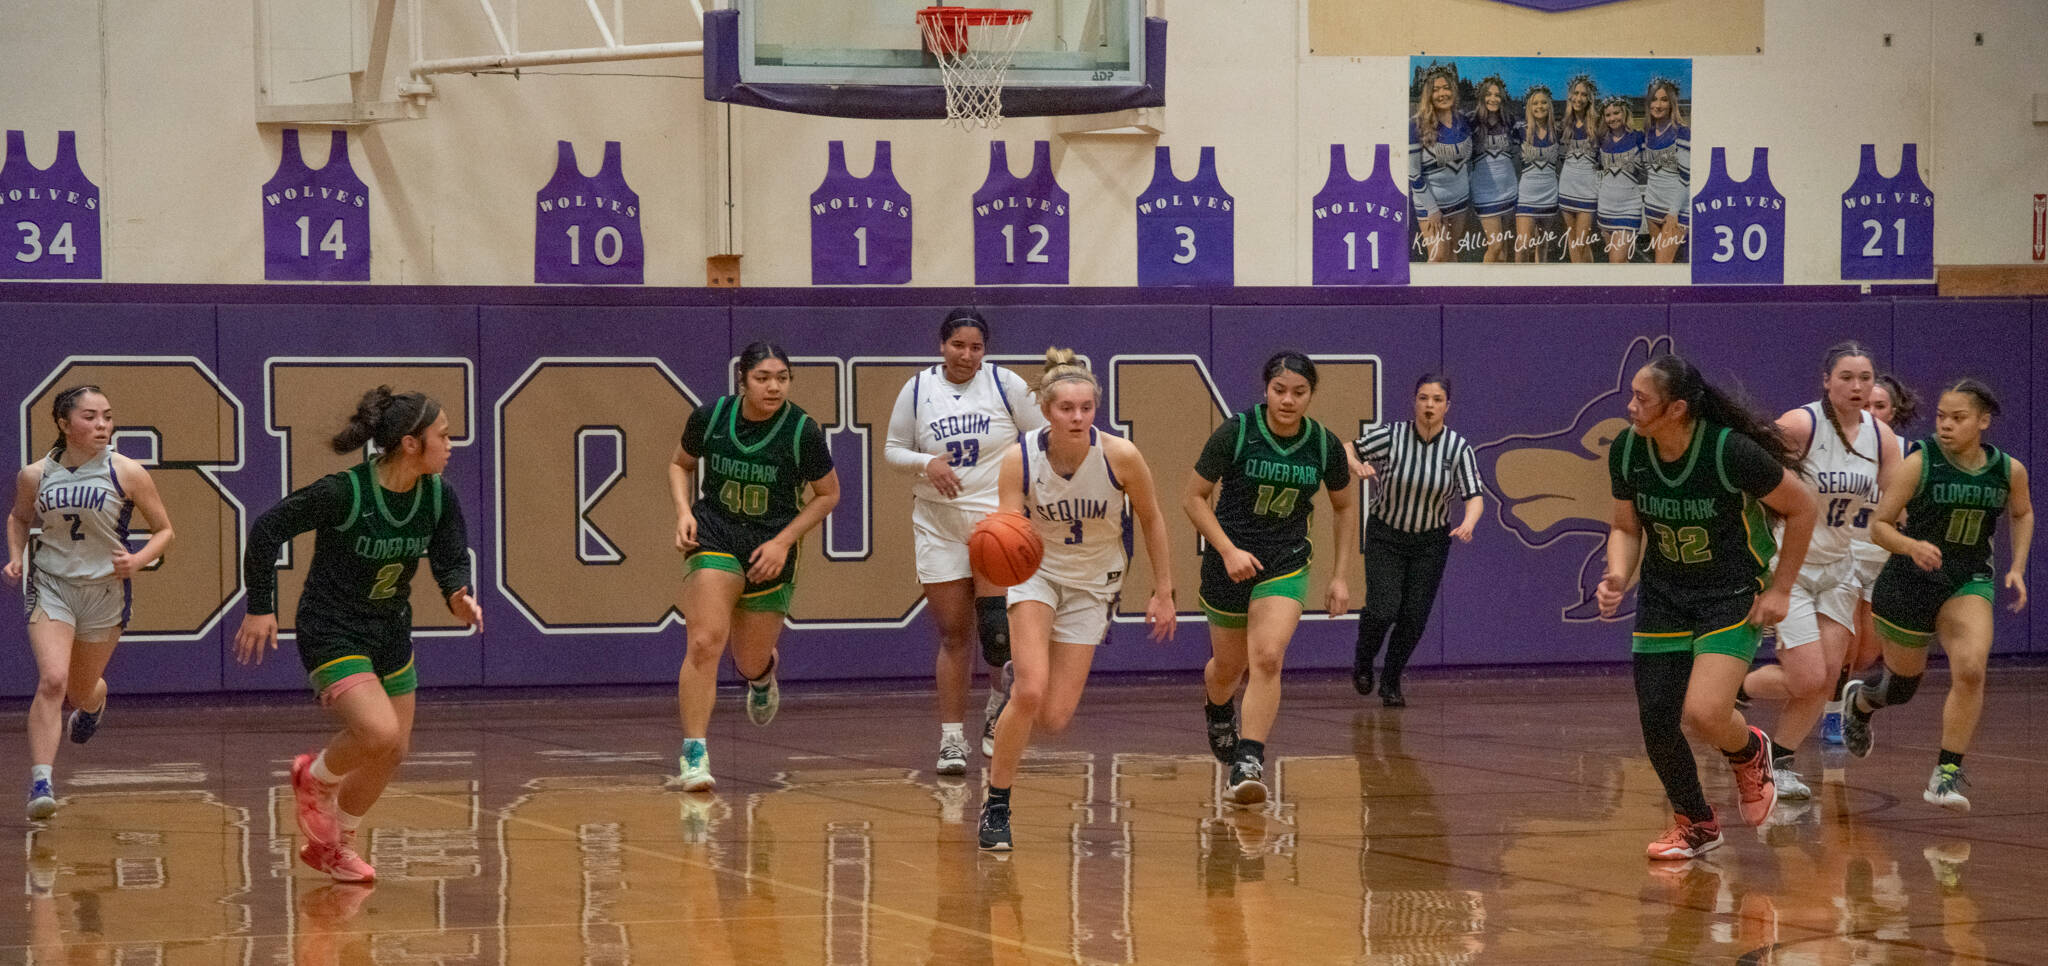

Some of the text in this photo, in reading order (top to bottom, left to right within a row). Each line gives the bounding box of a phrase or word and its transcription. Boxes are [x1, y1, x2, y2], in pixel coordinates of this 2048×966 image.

[266, 186, 364, 207] WOLVES
[539, 195, 637, 218] WOLVES
[813, 196, 909, 219] WOLVES
[976, 196, 1066, 217] WOLVES
[1138, 194, 1232, 215] WOLVES
[1694, 196, 1782, 214] WOLVES
[1844, 192, 1933, 210] WOLVES
[1314, 201, 1404, 224] WOLVES
[15, 221, 77, 263] 34
[295, 216, 347, 260] 14
[566, 225, 623, 266] 10
[853, 227, 867, 266] 1
[1001, 224, 1050, 263] 12
[1173, 225, 1197, 264] 3
[1342, 231, 1379, 270] 11
[1453, 229, 1513, 254] Allison
[1514, 228, 1557, 252] Claire
[1558, 227, 1600, 260] Julia
[1711, 223, 1768, 263] 30
[1862, 218, 1906, 257] 21
[930, 413, 991, 441] SEQUIM
[946, 438, 980, 467] 33
[711, 453, 779, 482] CLOVER PARK
[1244, 458, 1318, 486] CLOVER PARK
[20, 354, 1382, 641] SEQUM
[39, 485, 107, 513] SEQUIM
[720, 480, 769, 515] 40
[1253, 484, 1300, 519] 14
[1637, 492, 1718, 520] CLOVER PARK
[1933, 482, 1981, 506] CLOVER
[63, 513, 86, 541] 2
[1064, 519, 1083, 545] 3
[1945, 508, 1986, 546] 11
[355, 535, 403, 560] CLOVER
[1653, 522, 1713, 564] 32
[368, 562, 404, 600] 2
